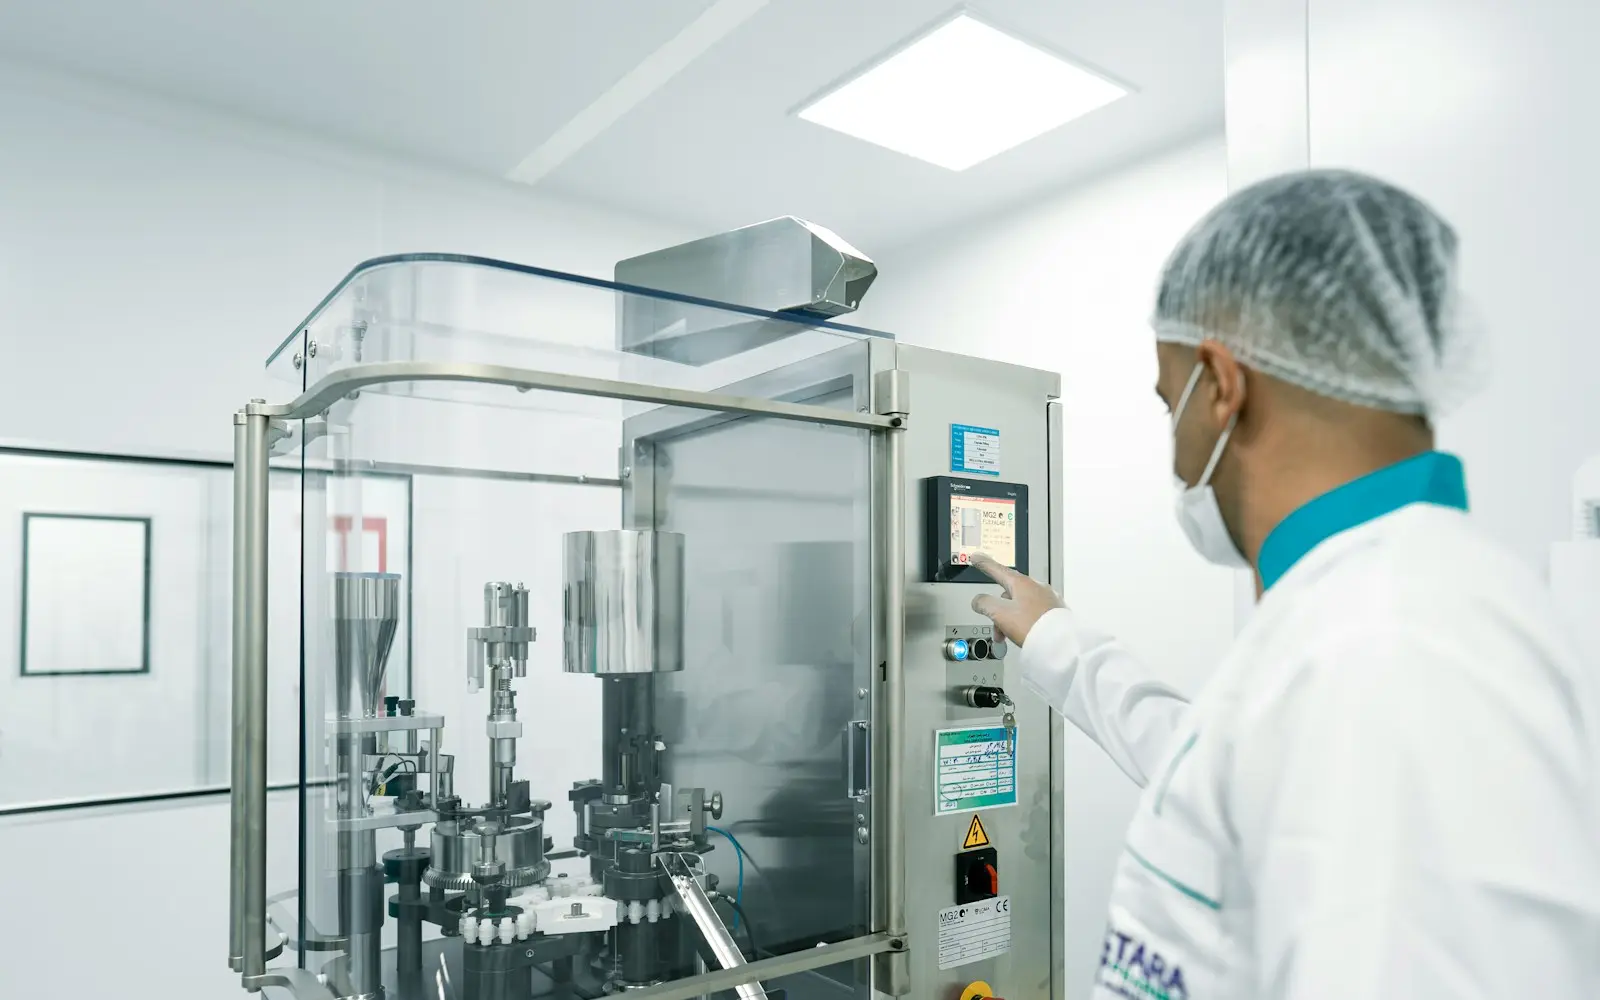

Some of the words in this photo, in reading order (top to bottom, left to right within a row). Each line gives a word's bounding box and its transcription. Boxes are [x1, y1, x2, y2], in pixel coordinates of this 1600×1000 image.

[983, 511, 997, 519] MG2
[879, 661, 887, 681] 1
[940, 910, 958, 923] MG2
